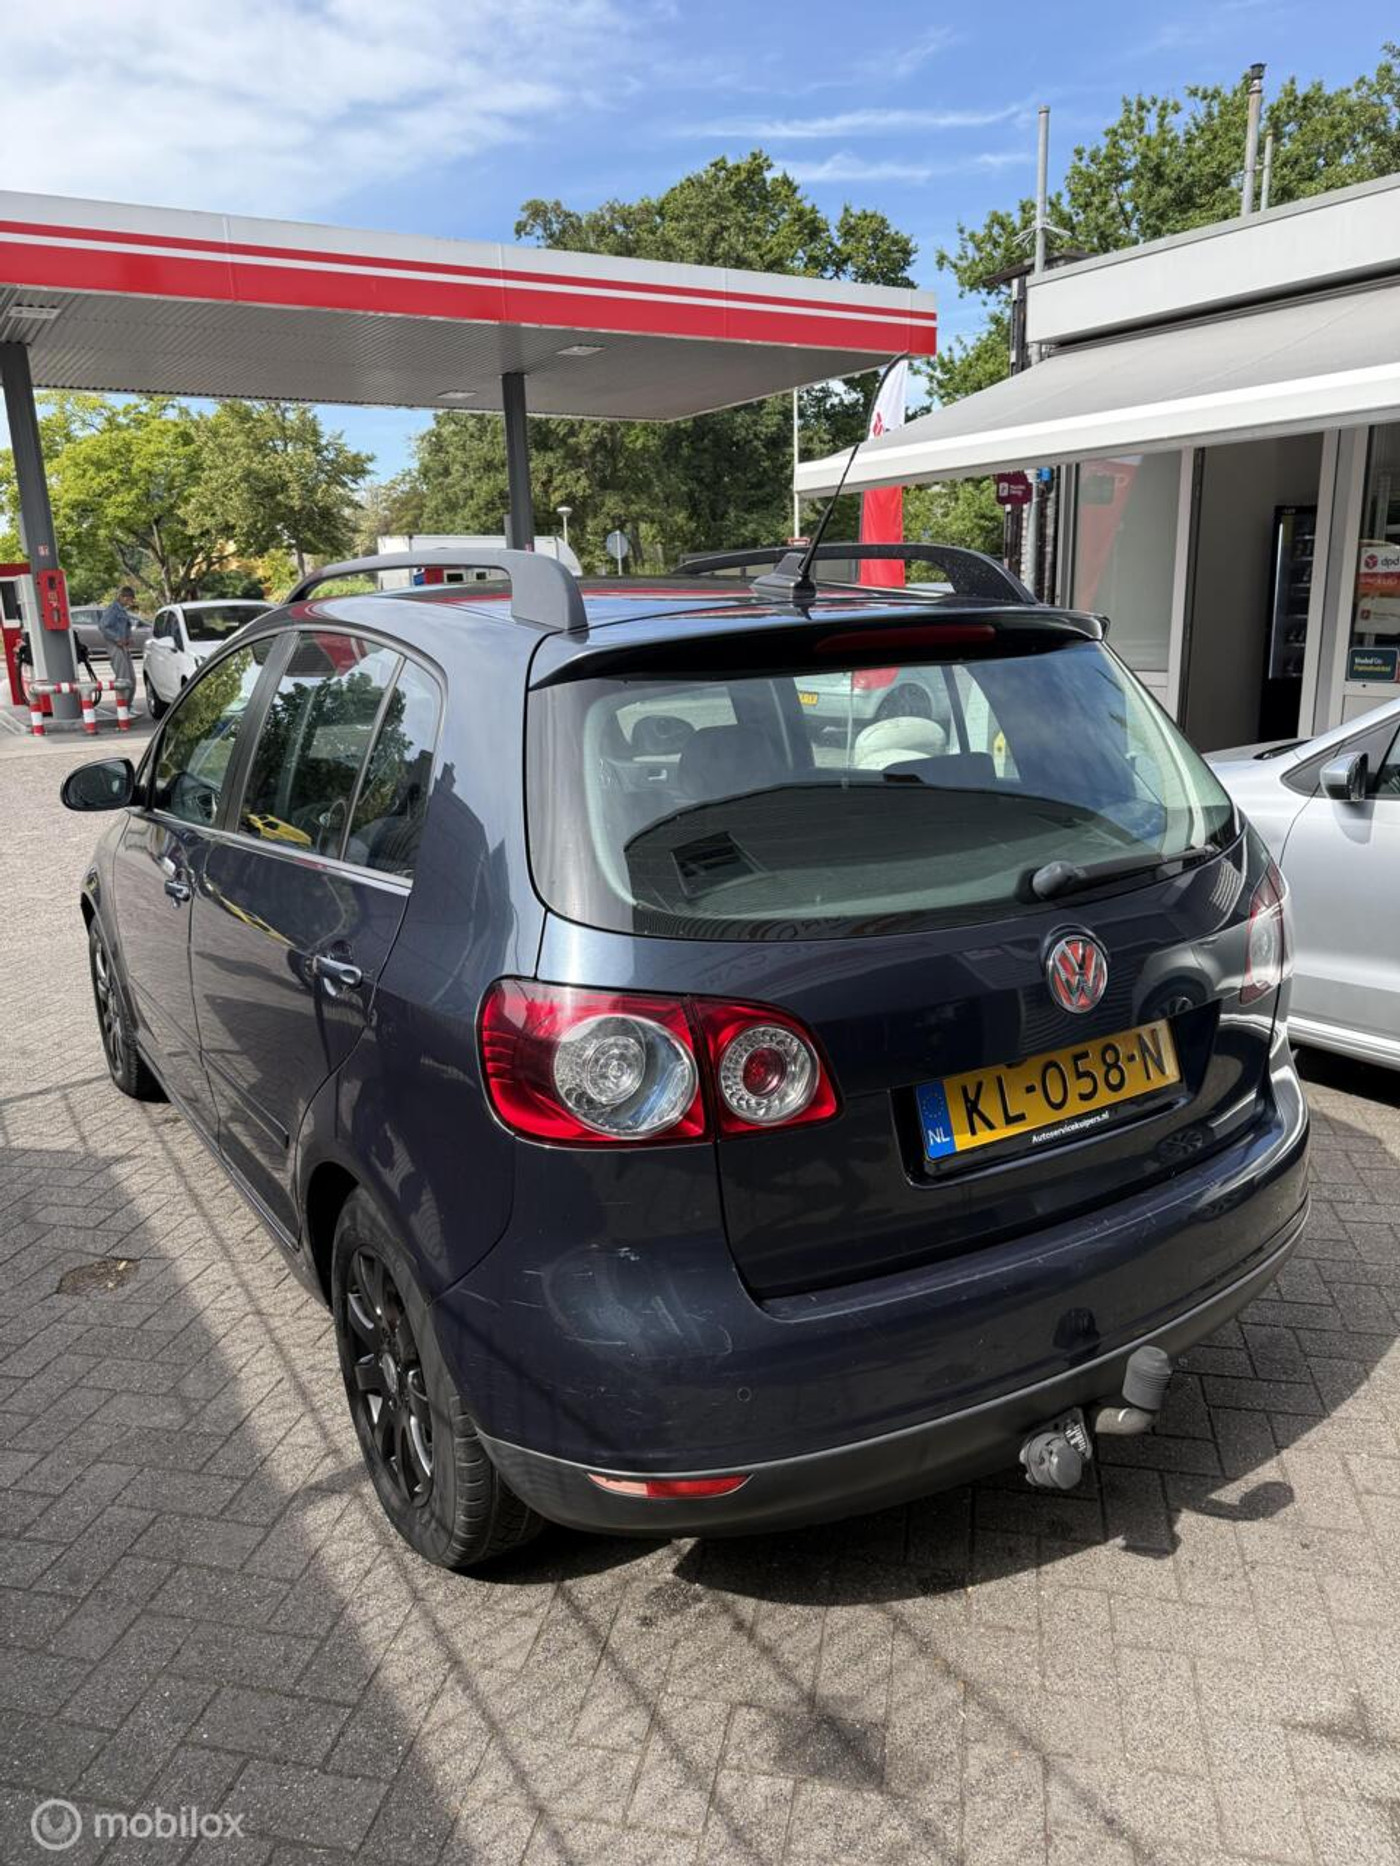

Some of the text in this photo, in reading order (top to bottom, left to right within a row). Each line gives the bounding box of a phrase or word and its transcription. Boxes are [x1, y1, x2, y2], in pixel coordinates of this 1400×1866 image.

[1381, 556, 1400, 569] dpd
[961, 1028, 1168, 1136] KL-058-N
[928, 1128, 950, 1145] NL
